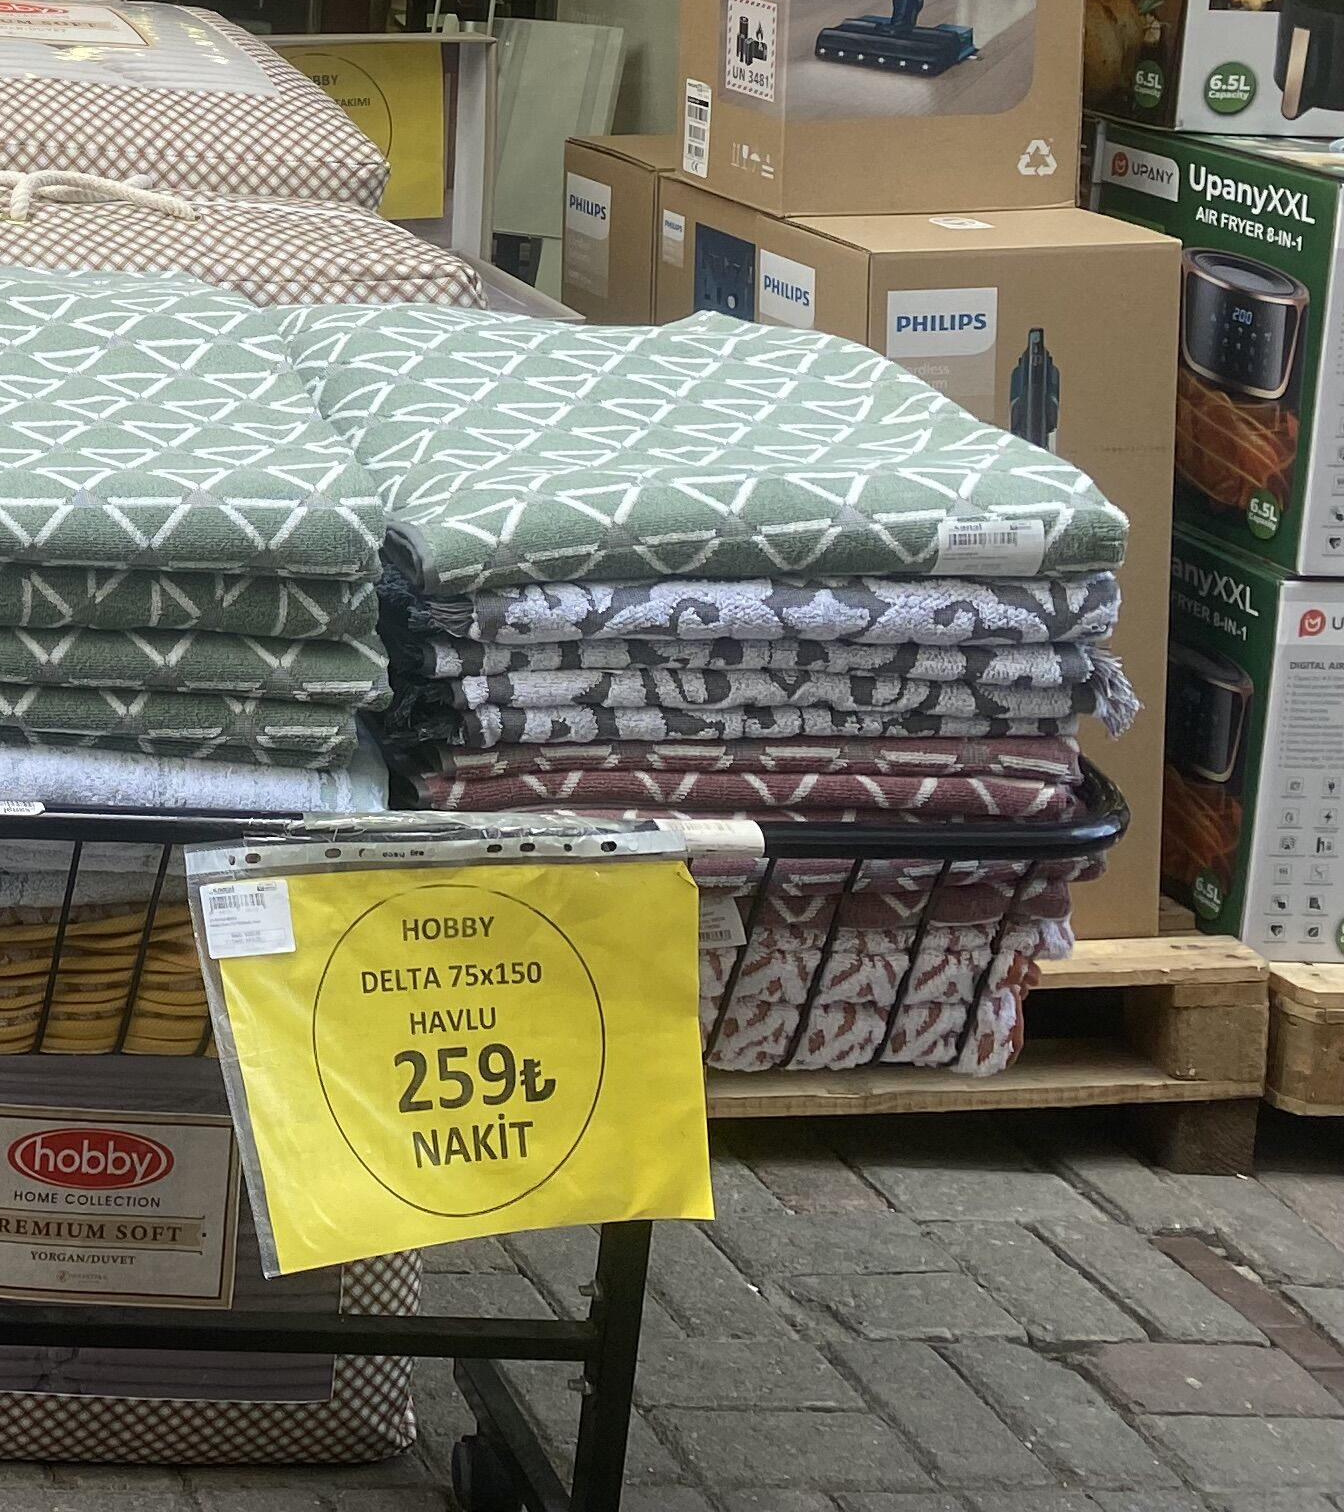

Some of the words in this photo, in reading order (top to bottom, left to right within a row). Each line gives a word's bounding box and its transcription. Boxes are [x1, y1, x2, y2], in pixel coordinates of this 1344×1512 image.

[732, 69, 746, 83] UN
[748, 71, 770, 88] 3481
[1136, 70, 1163, 89] 6.5L
[1209, 75, 1251, 91] 6.5L
[1208, 89, 1250, 101] Capacity
[1131, 162, 1174, 185] UPANY
[569, 194, 607, 221] PHILIPS
[1188, 163, 1316, 225] UpanyXXL
[1195, 206, 1218, 227] AIR
[1220, 213, 1264, 240] FRYER
[1266, 227, 1303, 252] 8-IN-1
[764, 275, 810, 307] PHILIPS
[896, 313, 987, 332] PHILIPS
[1249, 497, 1278, 522] 6.5L
[1213, 611, 1248, 641] 8-IN-1
[1289, 661, 1326, 671] DIGITAL
[1194, 876, 1221, 905] 6.5L
[401, 915, 496, 942] HOBBY
[361, 965, 442, 994] DELTA
[447, 960, 542, 988] 75x150
[409, 1006, 497, 1035] HAVLU
[393, 1041, 557, 1114] 259₺
[412, 1112, 534, 1169] NAKİT
[33, 1137, 153, 1184] hobby
[14, 1190, 59, 1205] HOME
[64, 1193, 161, 1209] COLLECTION
[115, 1223, 183, 1242] SOFT
[30, 1250, 137, 1266] YORGAN/DUVET
